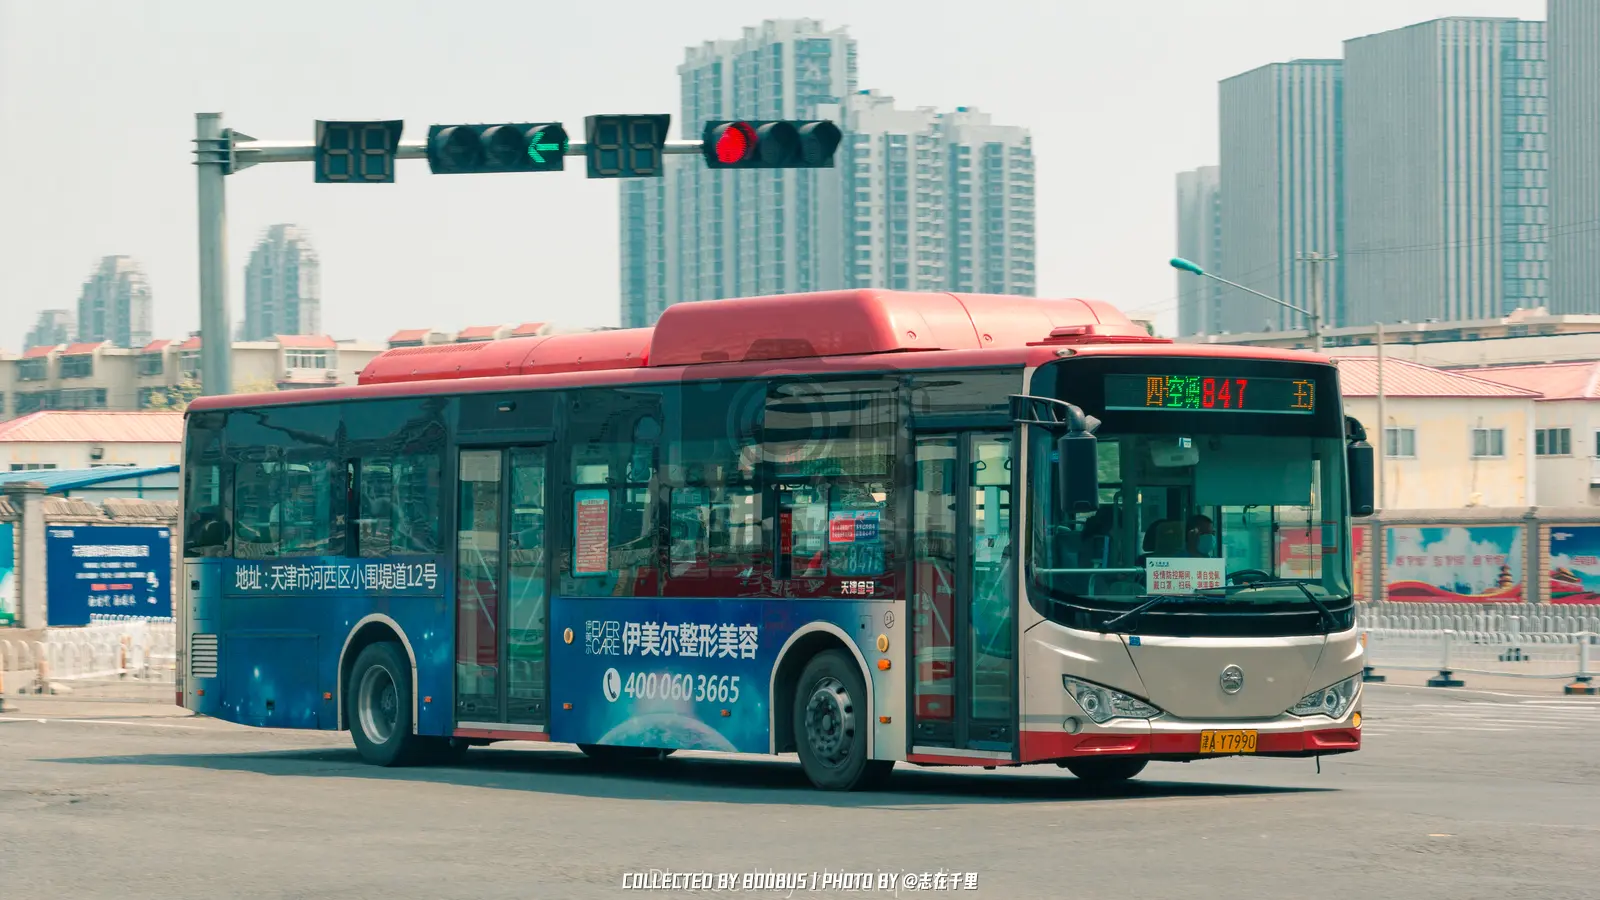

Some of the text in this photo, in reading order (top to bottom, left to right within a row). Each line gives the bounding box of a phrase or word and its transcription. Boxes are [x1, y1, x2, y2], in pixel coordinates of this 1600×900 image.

[591, 620, 621, 638] EVER
[591, 637, 621, 656] CARE
[622, 621, 759, 660] 伊美尔整形美容
